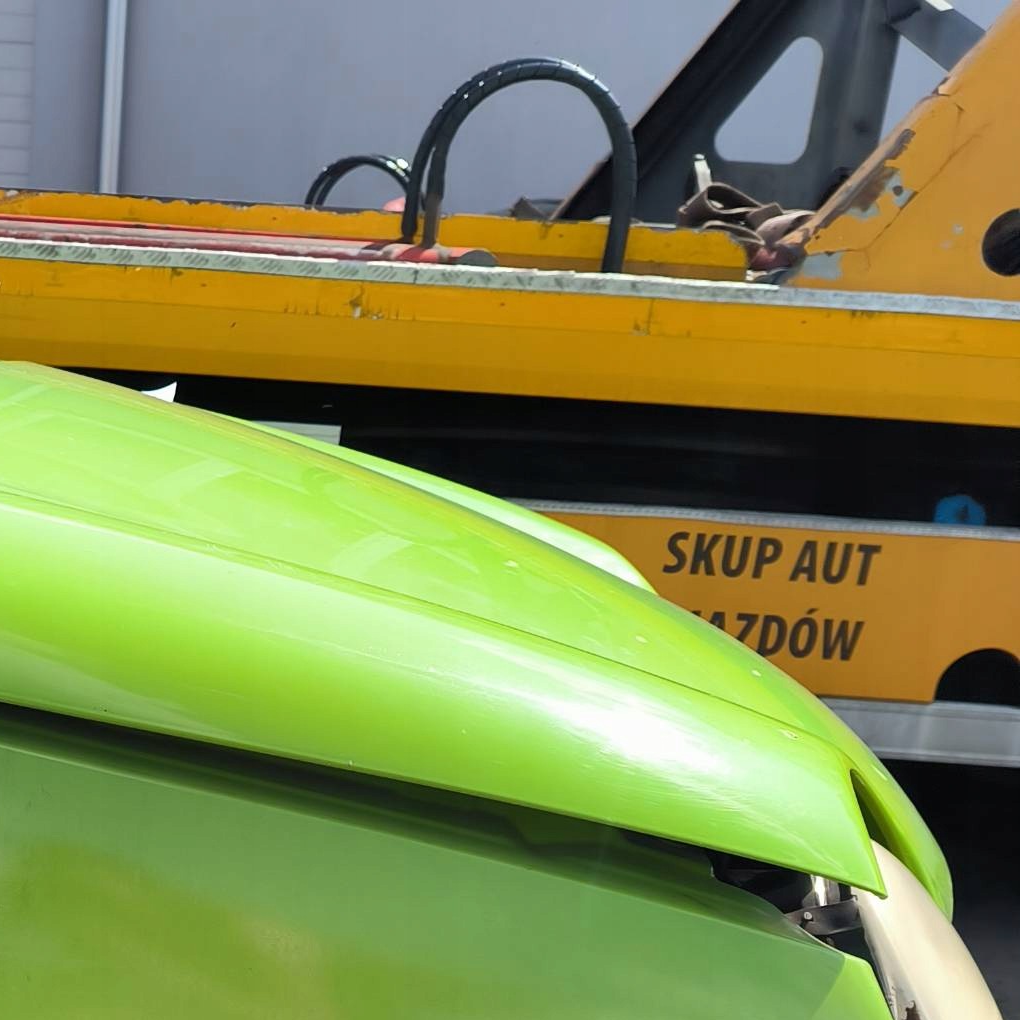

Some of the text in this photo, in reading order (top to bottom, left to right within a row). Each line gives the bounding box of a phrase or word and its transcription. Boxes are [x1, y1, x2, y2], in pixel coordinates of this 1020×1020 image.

[662, 531, 882, 586] SKUP AUT
[691, 608, 865, 661] ZDÓW
